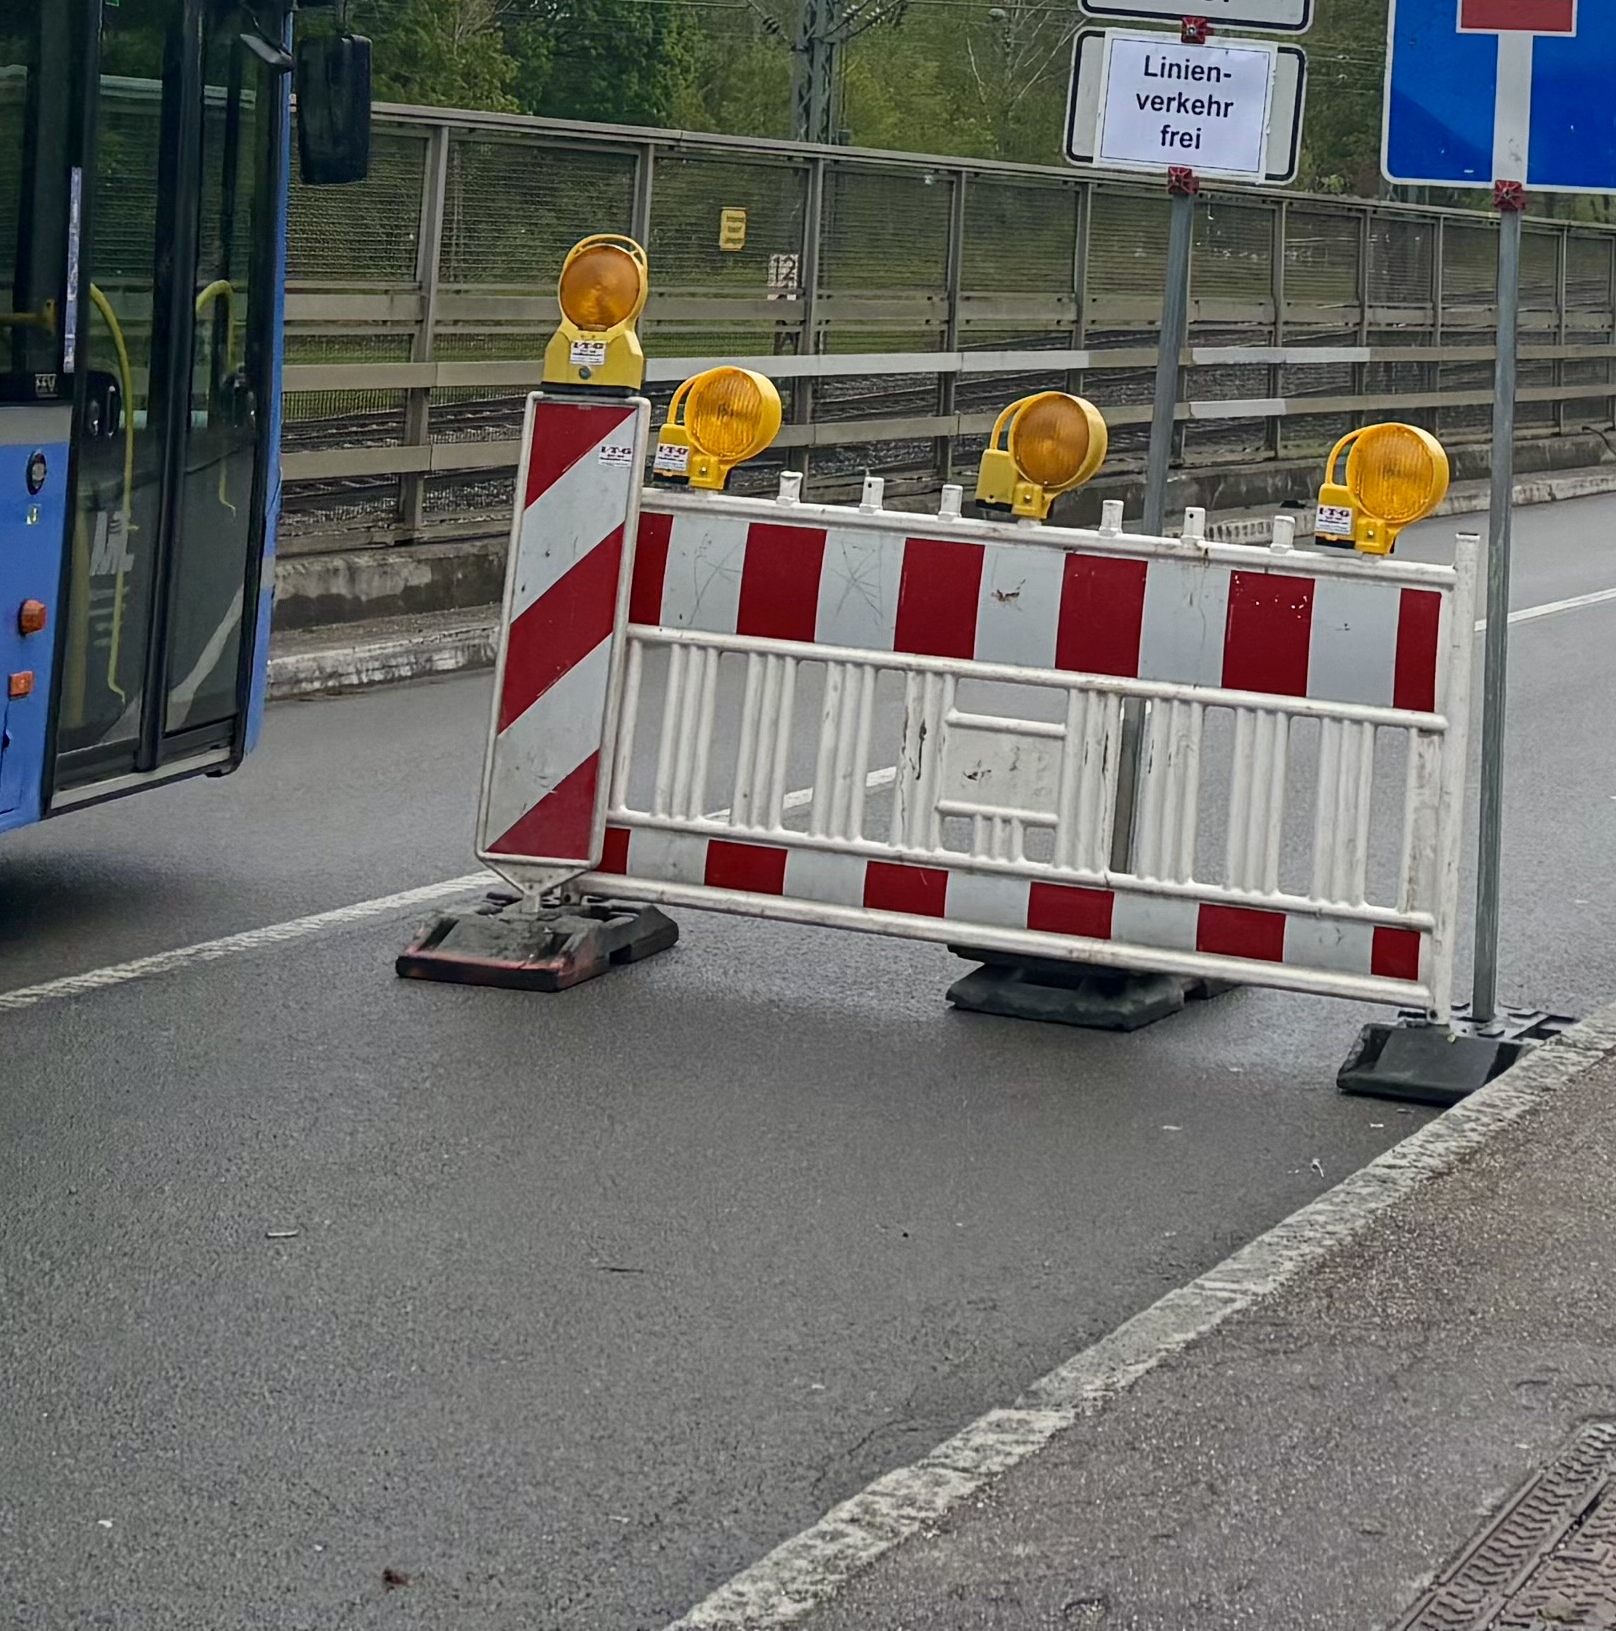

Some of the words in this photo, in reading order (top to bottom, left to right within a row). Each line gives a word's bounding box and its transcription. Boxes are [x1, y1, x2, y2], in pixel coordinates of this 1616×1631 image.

[1143, 54, 1232, 83] Linien-
[1135, 91, 1235, 118] verkehr
[1160, 124, 1202, 150] frei
